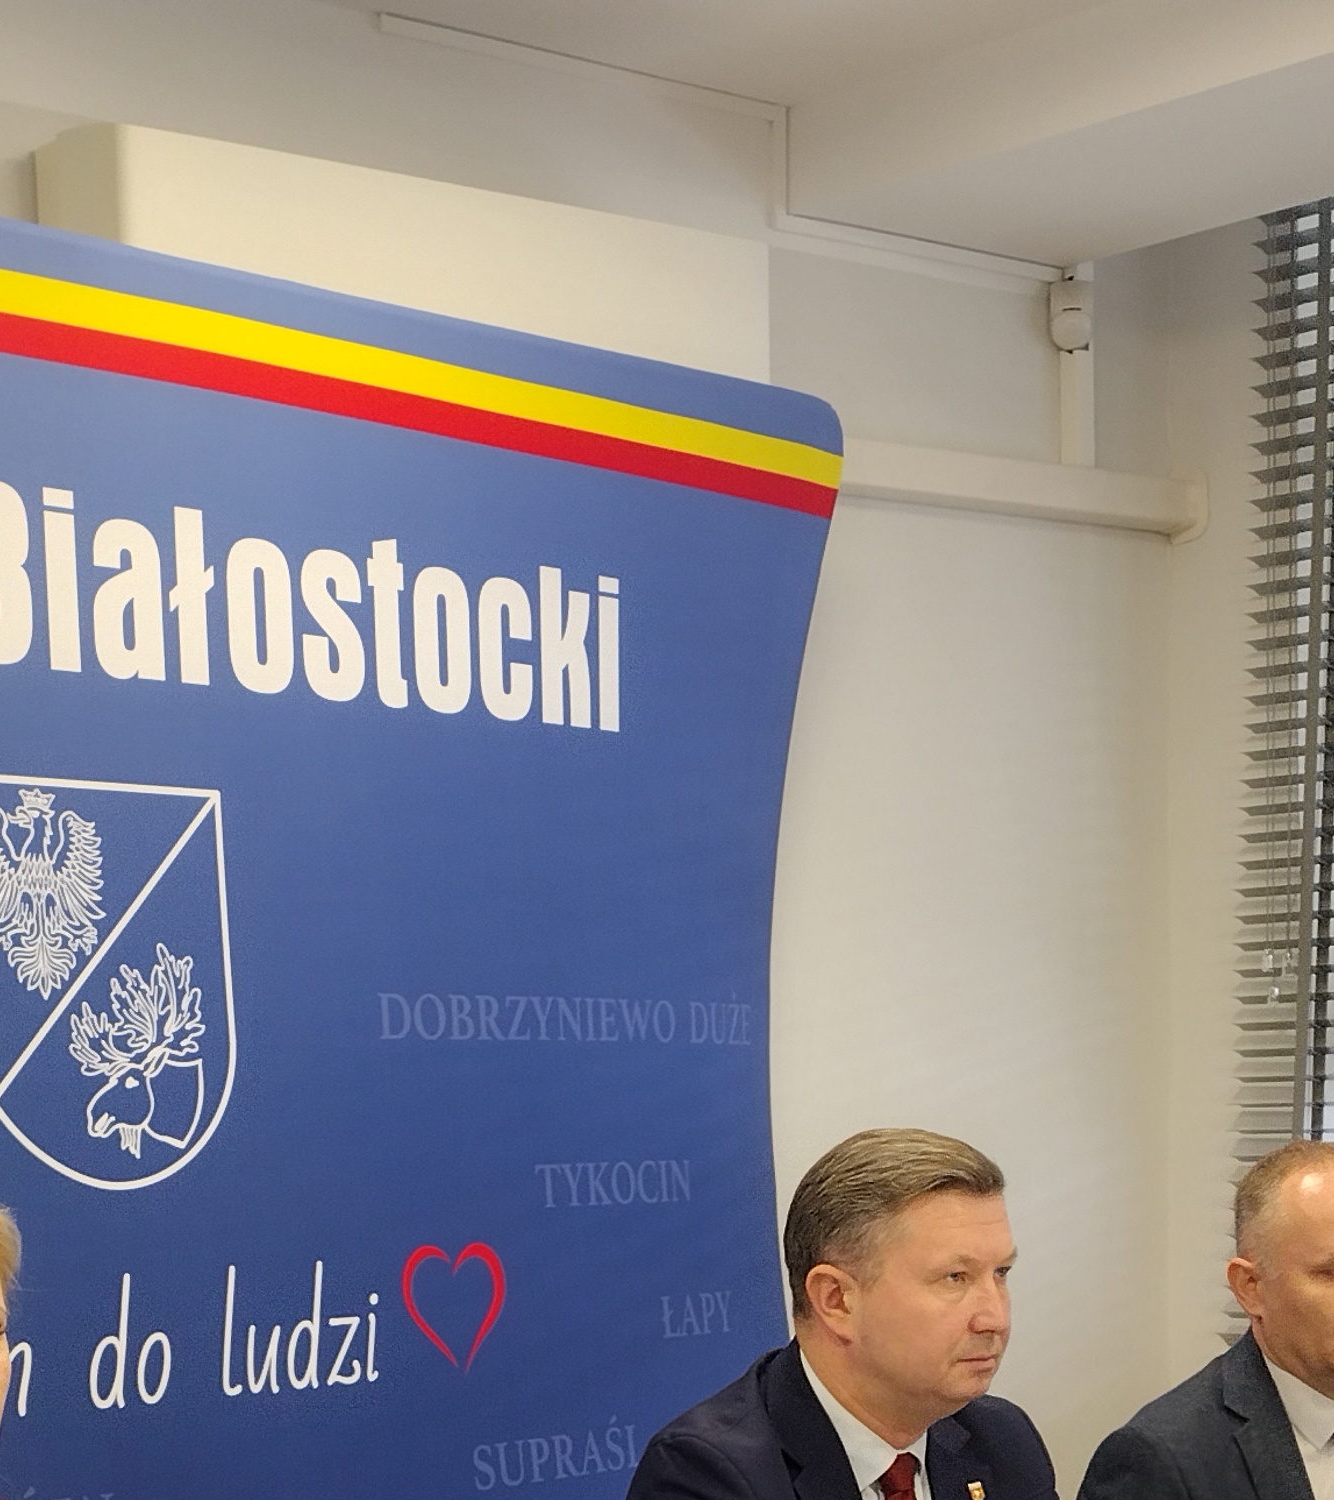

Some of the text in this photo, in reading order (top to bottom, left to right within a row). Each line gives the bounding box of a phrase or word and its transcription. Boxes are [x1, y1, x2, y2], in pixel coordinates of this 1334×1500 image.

[377, 993, 752, 1046] DOBRZYNIEWO DUŻE
[534, 1159, 692, 1209] TYKOCIN
[89, 1272, 172, 1409] do
[222, 1260, 381, 1399] ludzi
[660, 1291, 732, 1339] ŁAPY
[472, 1413, 641, 1491] SUPRAŚL
